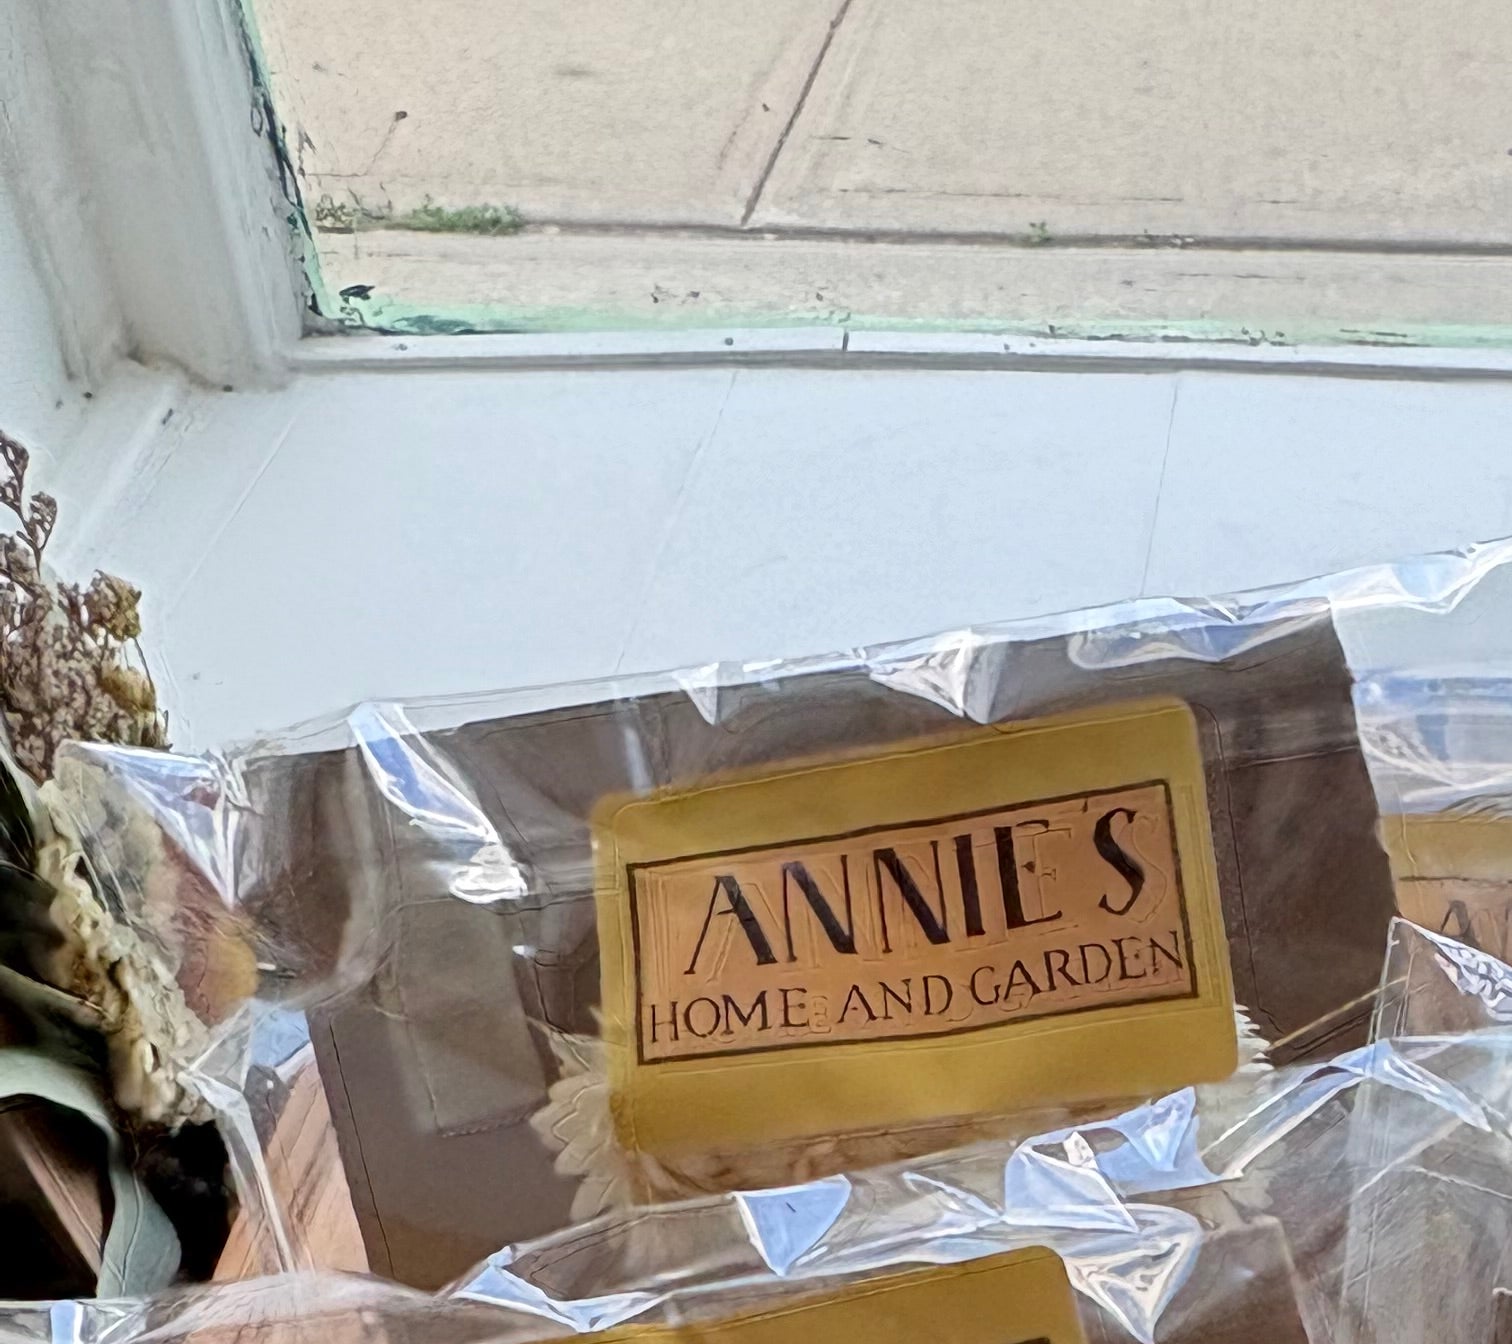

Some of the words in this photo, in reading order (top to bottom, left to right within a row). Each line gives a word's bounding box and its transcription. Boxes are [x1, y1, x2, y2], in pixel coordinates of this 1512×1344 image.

[686, 797, 1148, 974] ANNIE'S
[649, 986, 811, 1043] HOME
[836, 974, 954, 1023] AND
[969, 930, 1184, 1005] GARDEN
